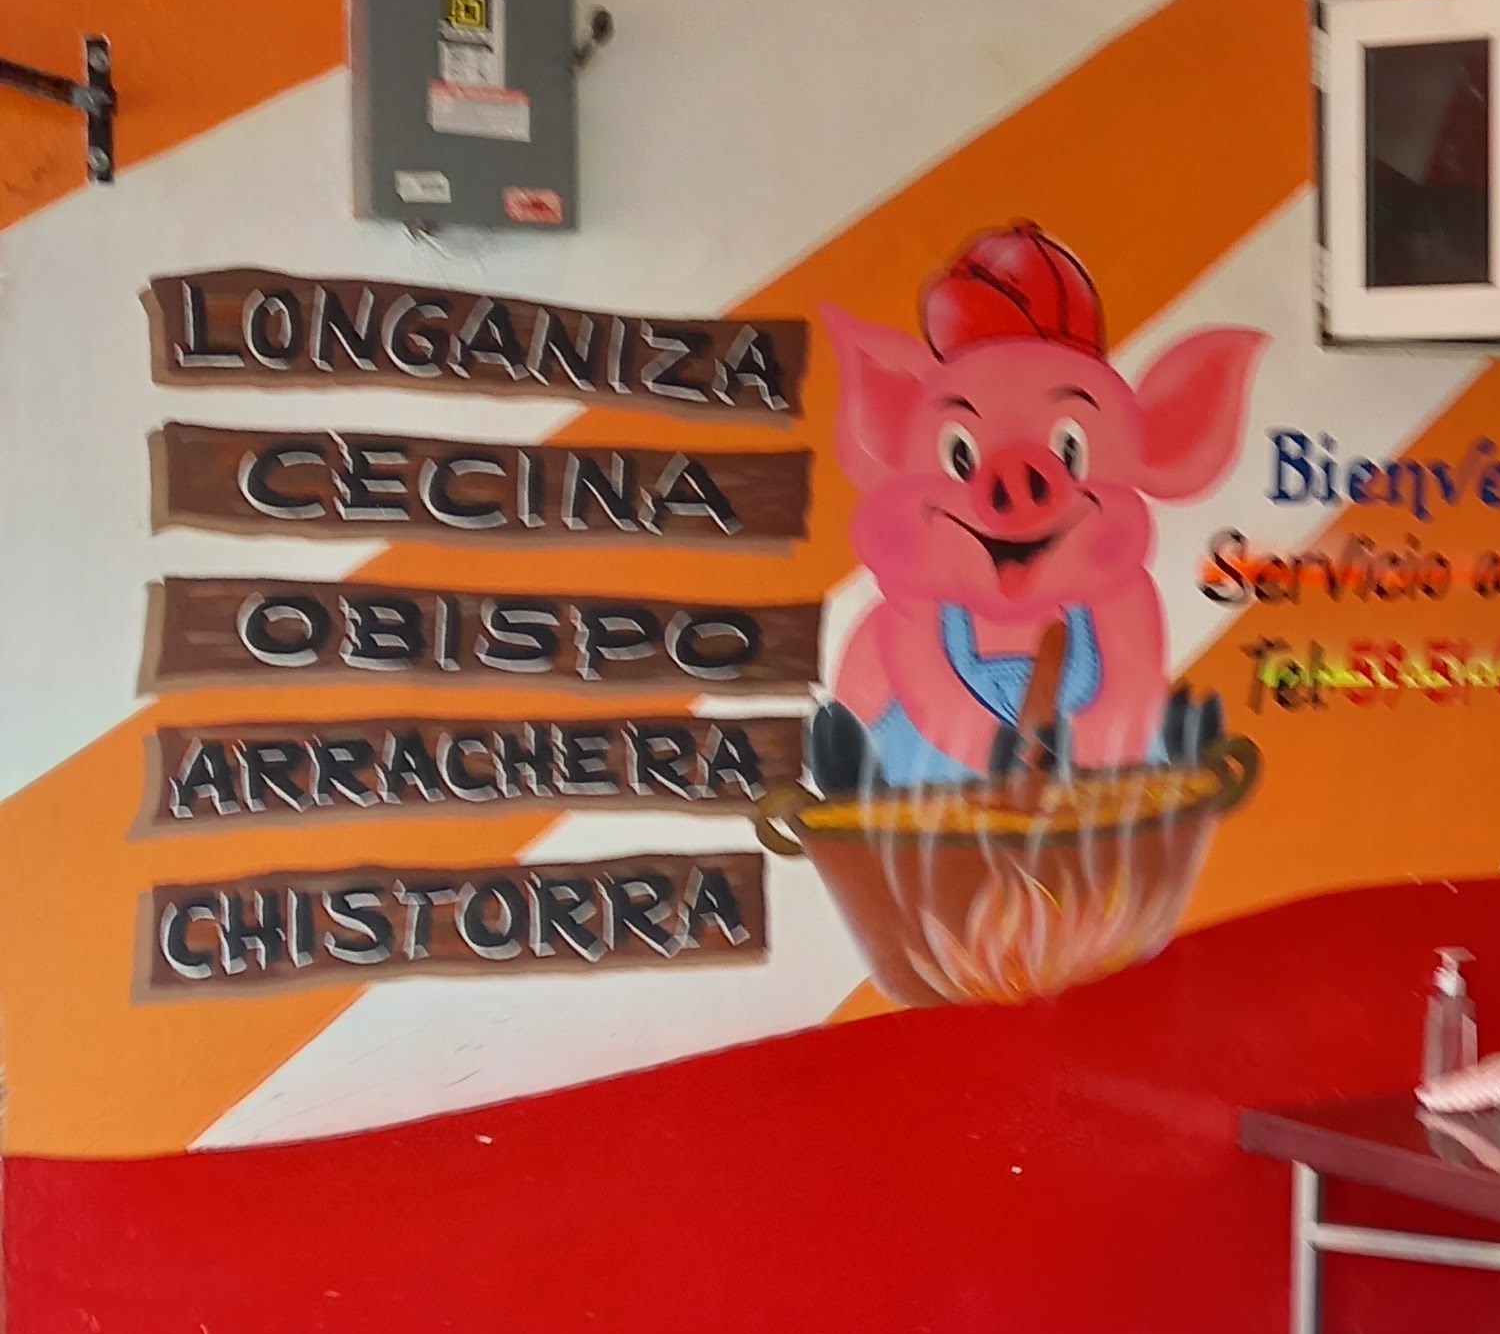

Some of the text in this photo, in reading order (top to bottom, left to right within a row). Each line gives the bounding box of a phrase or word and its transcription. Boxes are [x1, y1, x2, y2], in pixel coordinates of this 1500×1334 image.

[174, 279, 790, 411] LONGANIZA
[237, 429, 744, 536] CECINA
[1197, 527, 1452, 605] Servicio
[235, 592, 763, 681] OBISPO
[170, 720, 768, 819] ARRACHERA
[160, 865, 752, 980] CHISTORRA
